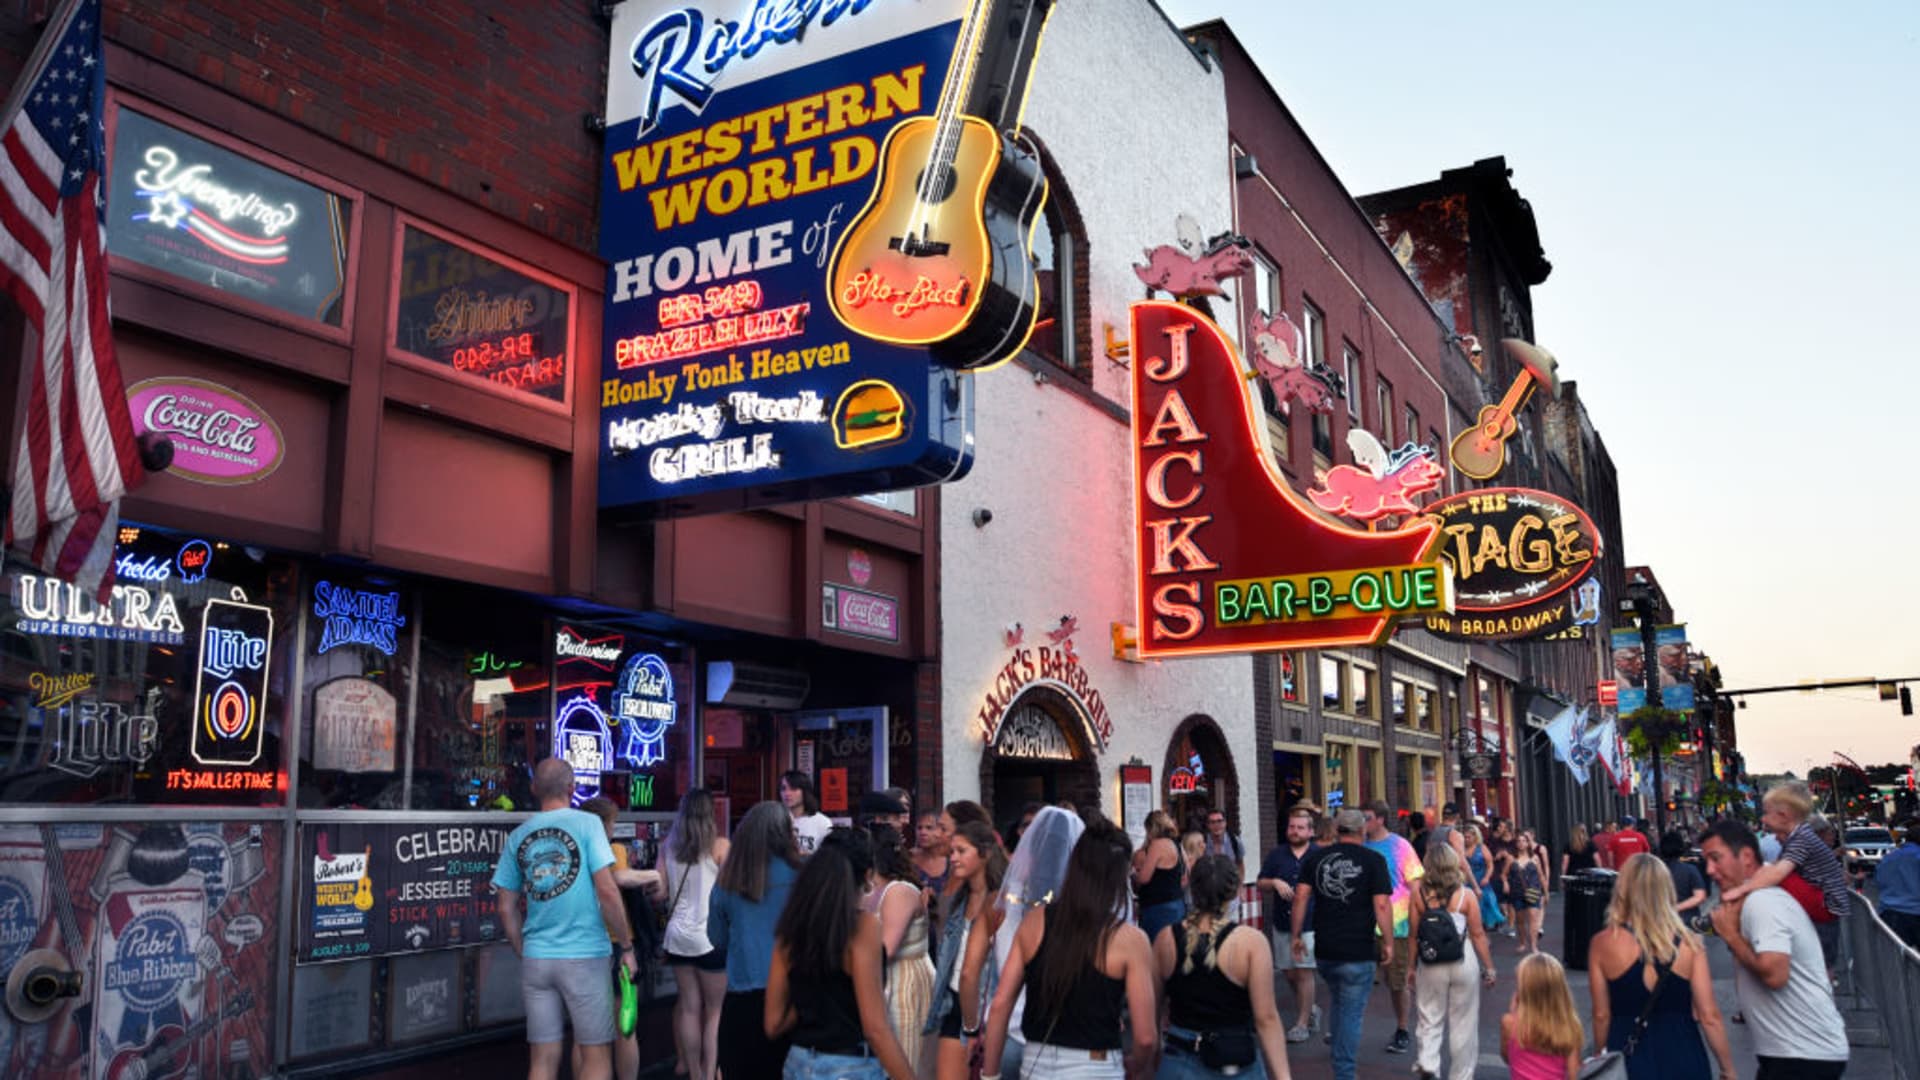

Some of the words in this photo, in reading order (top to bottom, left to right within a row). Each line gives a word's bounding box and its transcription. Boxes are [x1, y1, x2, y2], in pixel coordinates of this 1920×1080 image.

[612, 65, 926, 191] WESTERN
[648, 136, 878, 232] WORLD
[613, 221, 793, 303] HOME
[802, 204, 843, 267] of
[602, 370, 677, 407] Honky
[683, 355, 744, 392] Tonk
[751, 341, 850, 380] Heaven
[144, 394, 259, 453] Coca-Cola
[1468, 495, 1507, 514] THE
[314, 580, 406, 627] SAMUEL
[1217, 568, 1439, 623] BAR-B-QUE
[20, 620, 97, 637] SUPERIOR
[104, 629, 144, 641] LIGHT
[318, 615, 397, 655] ADAMS
[1461, 605, 1565, 635] BROADWAY
[556, 632, 625, 661] Budweiser
[979, 648, 1036, 747] JACK'S
[317, 858, 363, 880] Robert's
[389, 905, 429, 923] STICK
[436, 902, 468, 919] WITH
[127, 924, 177, 958] Pabst
[106, 964, 142, 990] Blue
[143, 957, 197, 984] Ribbon
